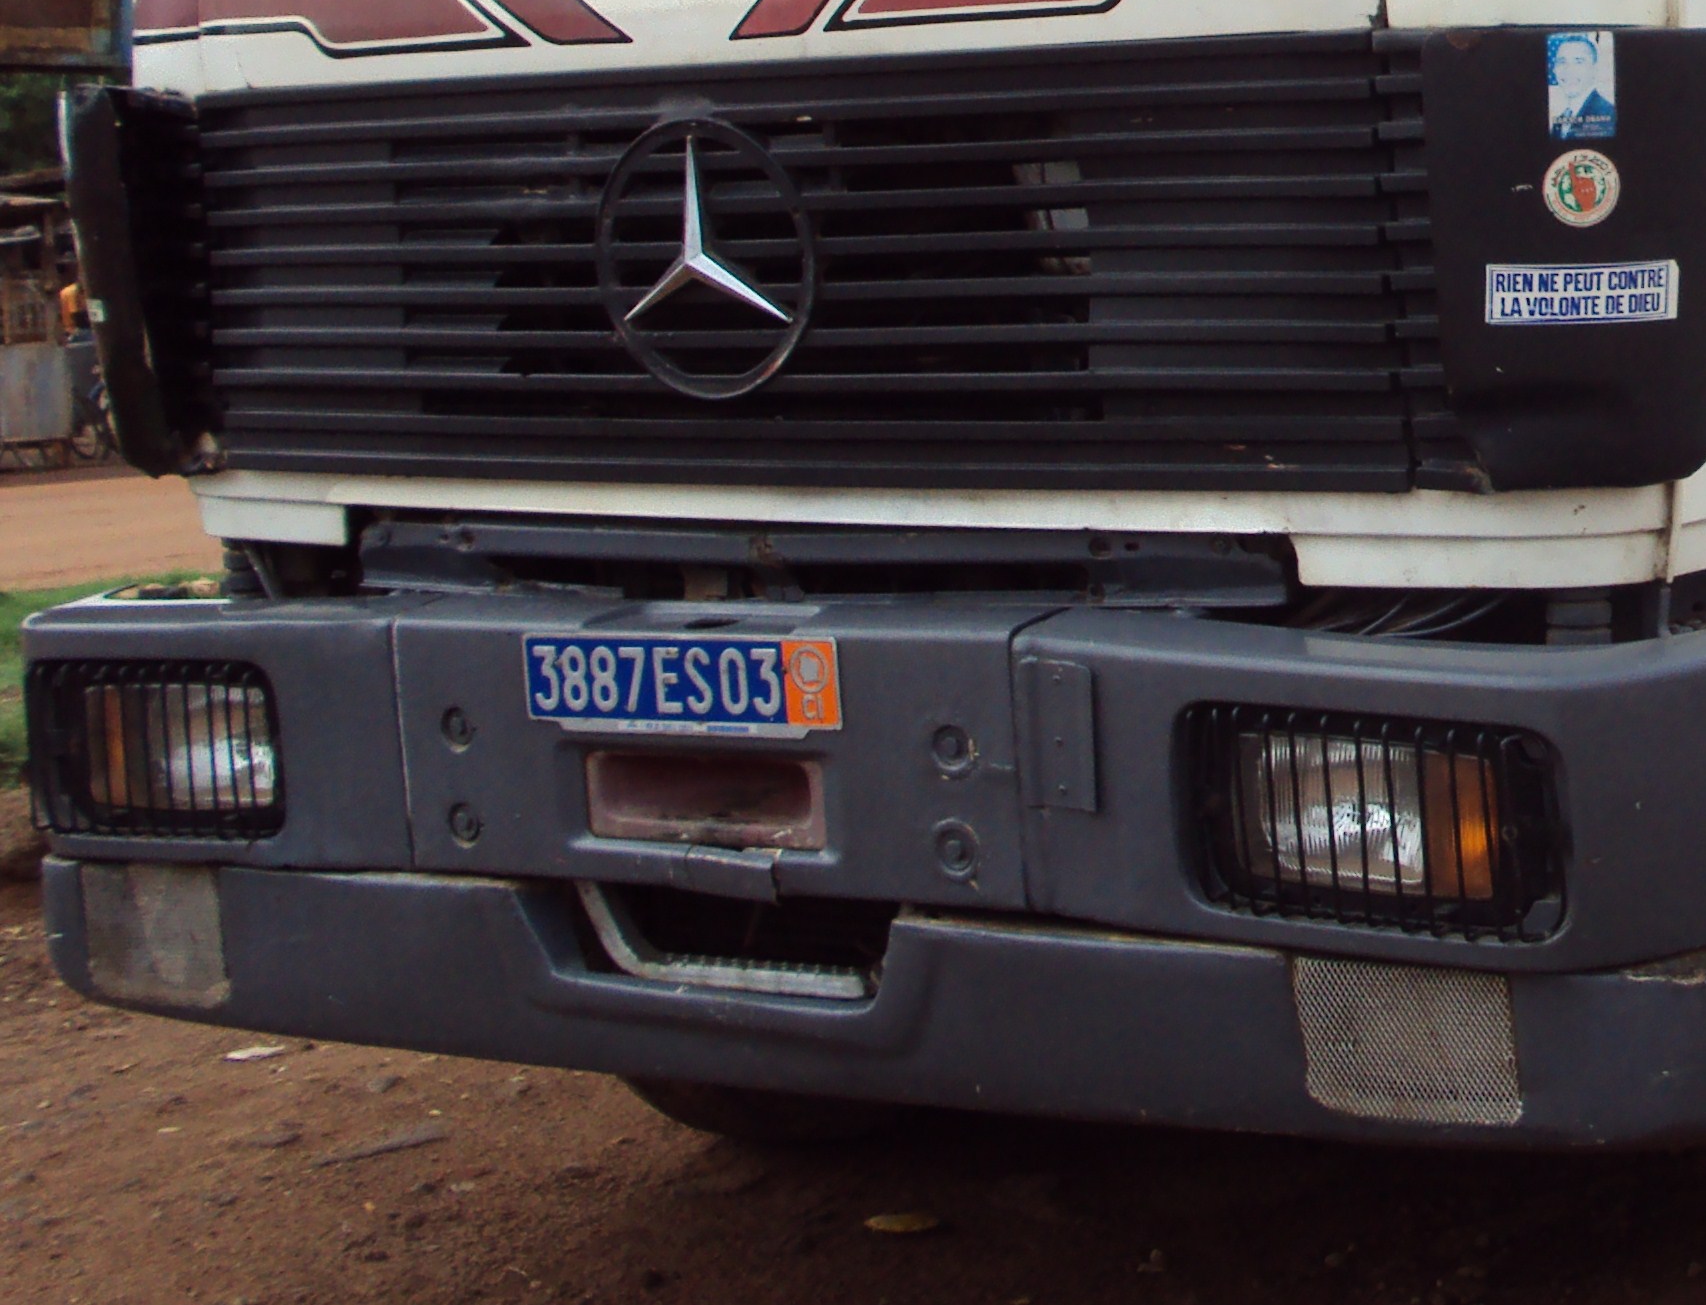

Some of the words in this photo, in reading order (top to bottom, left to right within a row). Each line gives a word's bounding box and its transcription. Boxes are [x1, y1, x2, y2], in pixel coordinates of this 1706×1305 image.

[1496, 273, 1534, 293] RIEN
[1538, 273, 1560, 292] NE
[1563, 272, 1604, 292] PEUT
[1608, 268, 1665, 290] CONTRE
[1501, 296, 1522, 317] LA
[1526, 296, 1600, 316] VOLONTE
[1605, 295, 1624, 314] DE
[1628, 293, 1660, 313] DIEU
[532, 644, 782, 717] 3887ES03
